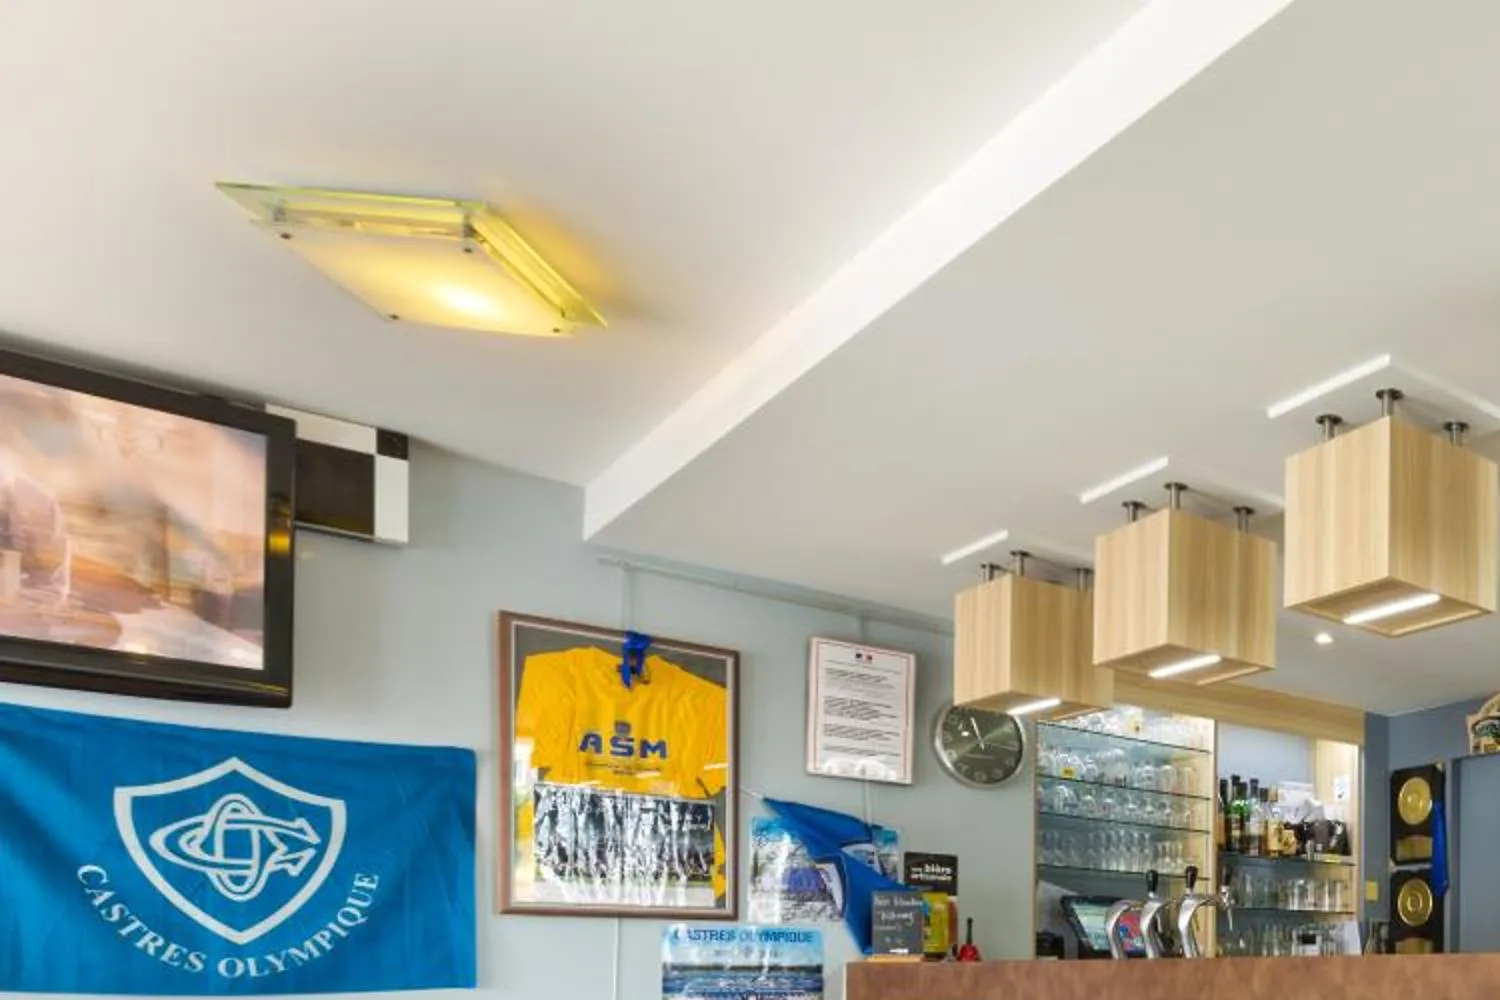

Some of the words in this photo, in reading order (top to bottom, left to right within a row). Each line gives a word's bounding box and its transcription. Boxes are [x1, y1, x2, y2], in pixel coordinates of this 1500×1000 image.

[579, 732, 667, 759] ASM
[76, 864, 203, 974] CASTRES
[217, 871, 379, 979] OLYMPIQUE
